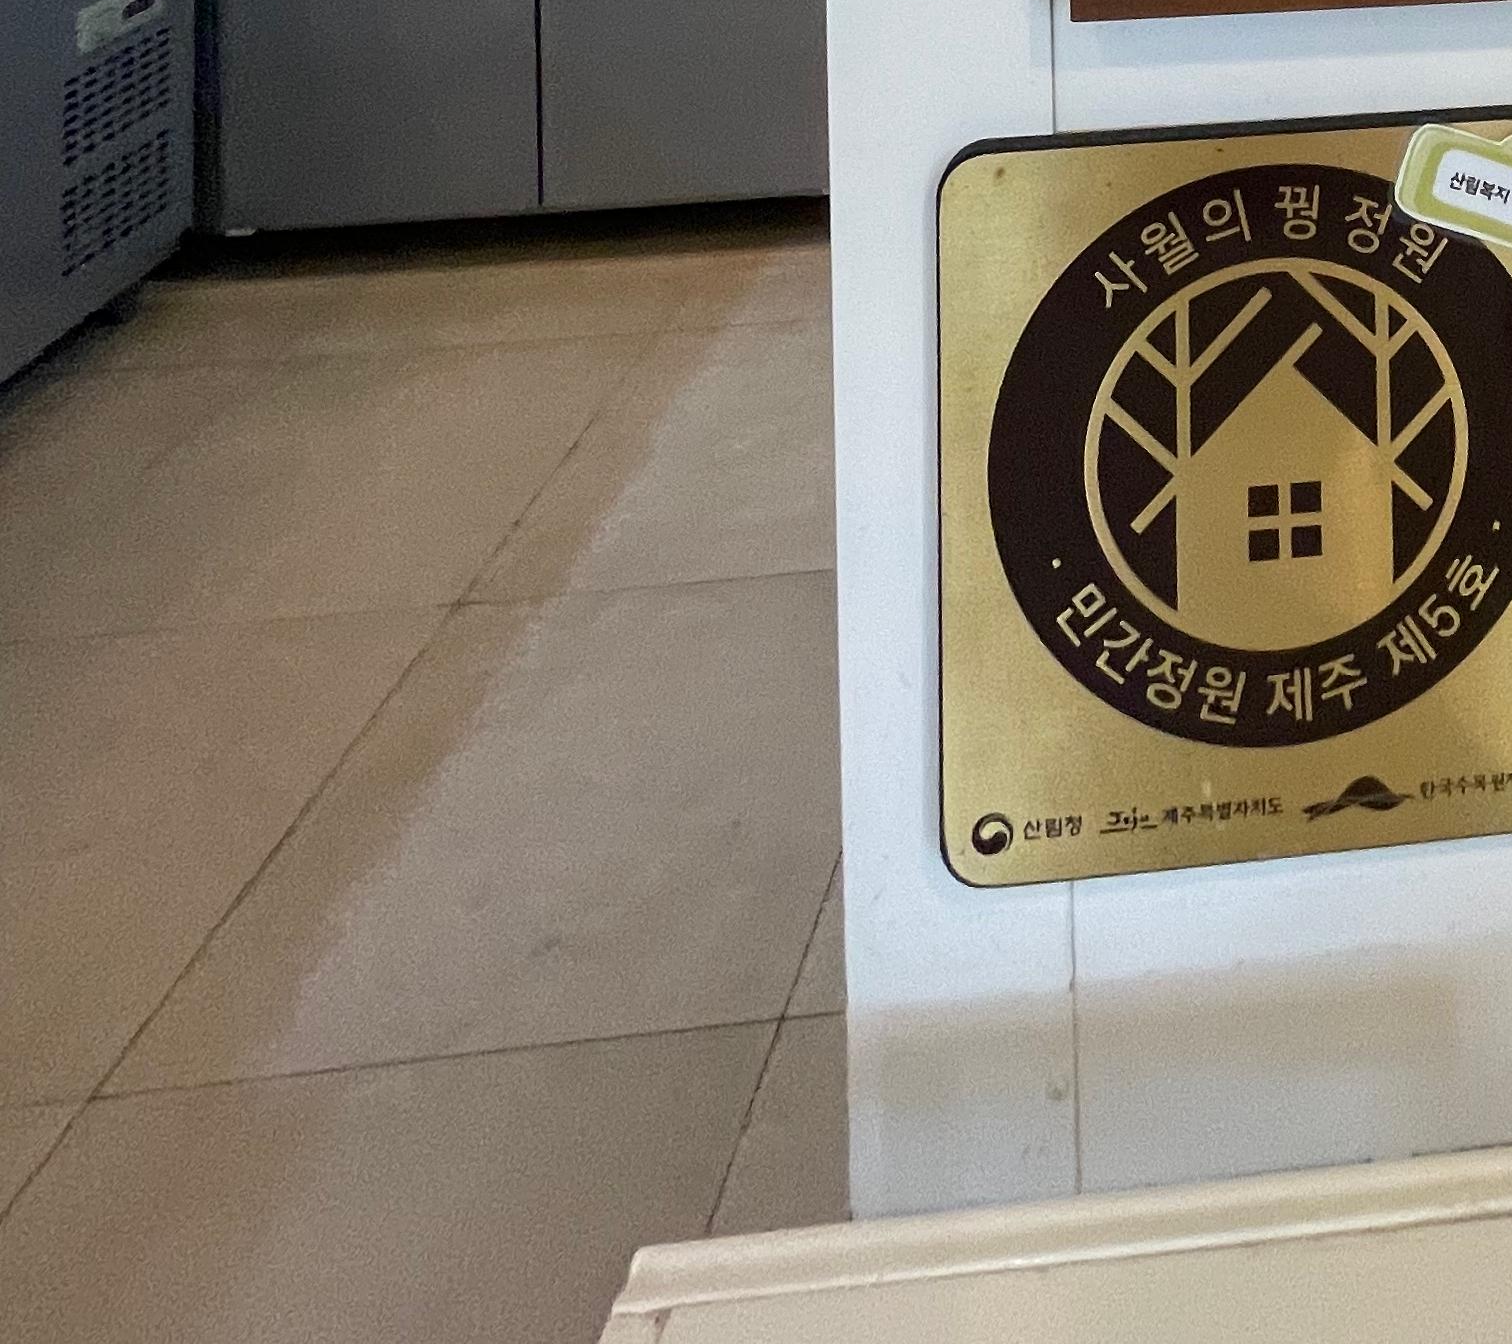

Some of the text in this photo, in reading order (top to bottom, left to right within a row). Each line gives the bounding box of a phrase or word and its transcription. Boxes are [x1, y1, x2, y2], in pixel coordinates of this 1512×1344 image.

[1449, 171, 1511, 205] 산림복지
[1096, 184, 1449, 308] 사월의 꿩 정원
[1056, 553, 1499, 725] 민간정원 제주 제5호
[1023, 815, 1083, 840] 산림청
[1161, 796, 1284, 825] 제주특별자치도
